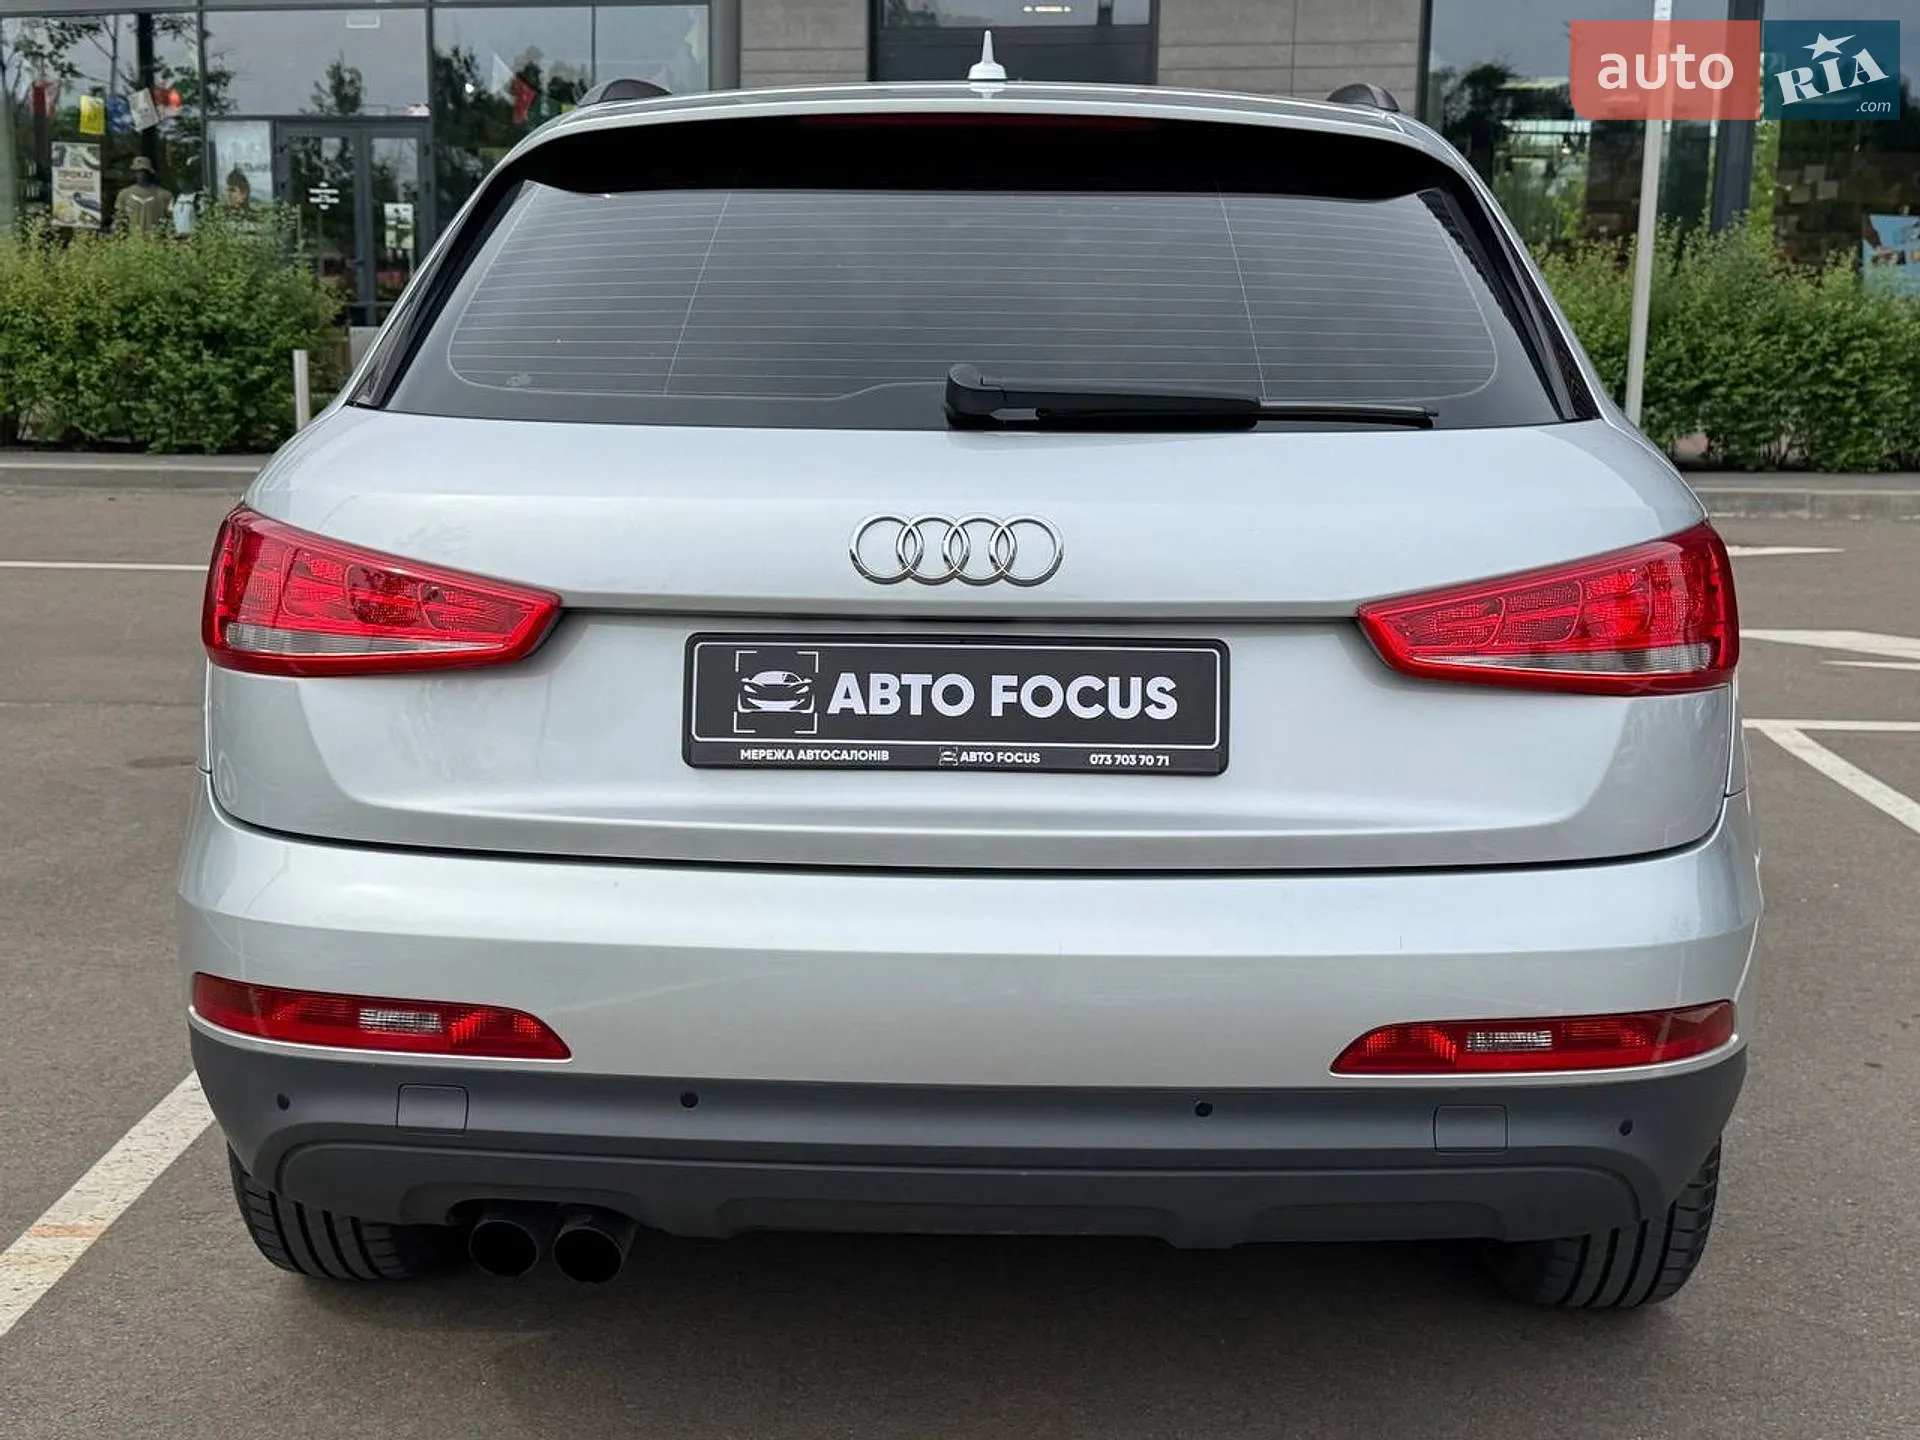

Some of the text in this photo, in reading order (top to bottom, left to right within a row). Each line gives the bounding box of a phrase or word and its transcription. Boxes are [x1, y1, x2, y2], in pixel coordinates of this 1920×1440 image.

[827, 673, 1177, 719] АВТО FOCUS
[740, 749, 889, 761] МЕРЕЖА АВТОСАЛОНІВ
[960, 751, 1041, 764] АВТО FOCUS
[1090, 754, 1170, 766] 073 703 70 71
